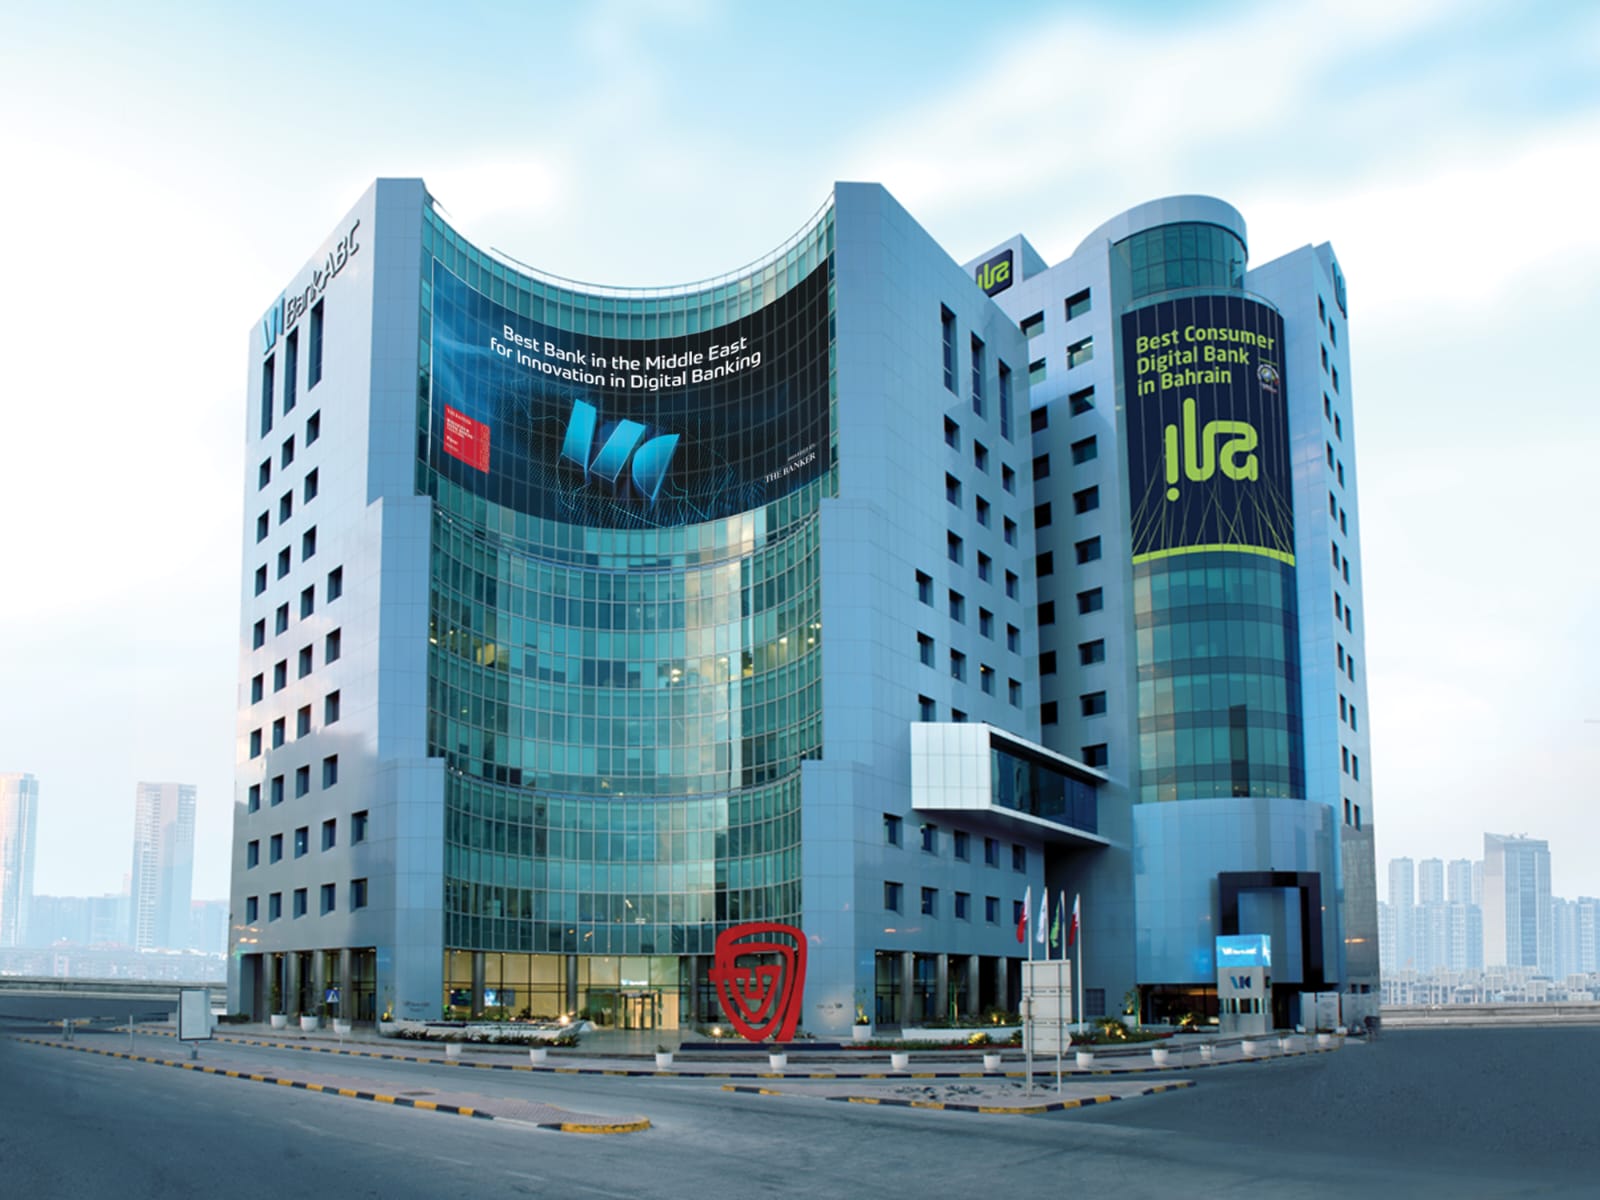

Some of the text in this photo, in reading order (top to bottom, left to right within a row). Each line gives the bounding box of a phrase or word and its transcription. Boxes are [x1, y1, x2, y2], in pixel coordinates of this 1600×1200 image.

[503, 324, 747, 370] Best Bank in the Middle East
[1136, 325, 1275, 354] Best Consumer
[490, 337, 761, 391] for Innovation in Digital Banking
[1136, 345, 1250, 375] Digital Bank
[1137, 366, 1232, 396] in Bahrain
[764, 472, 783, 483] THE
[783, 452, 816, 476] BANKER
